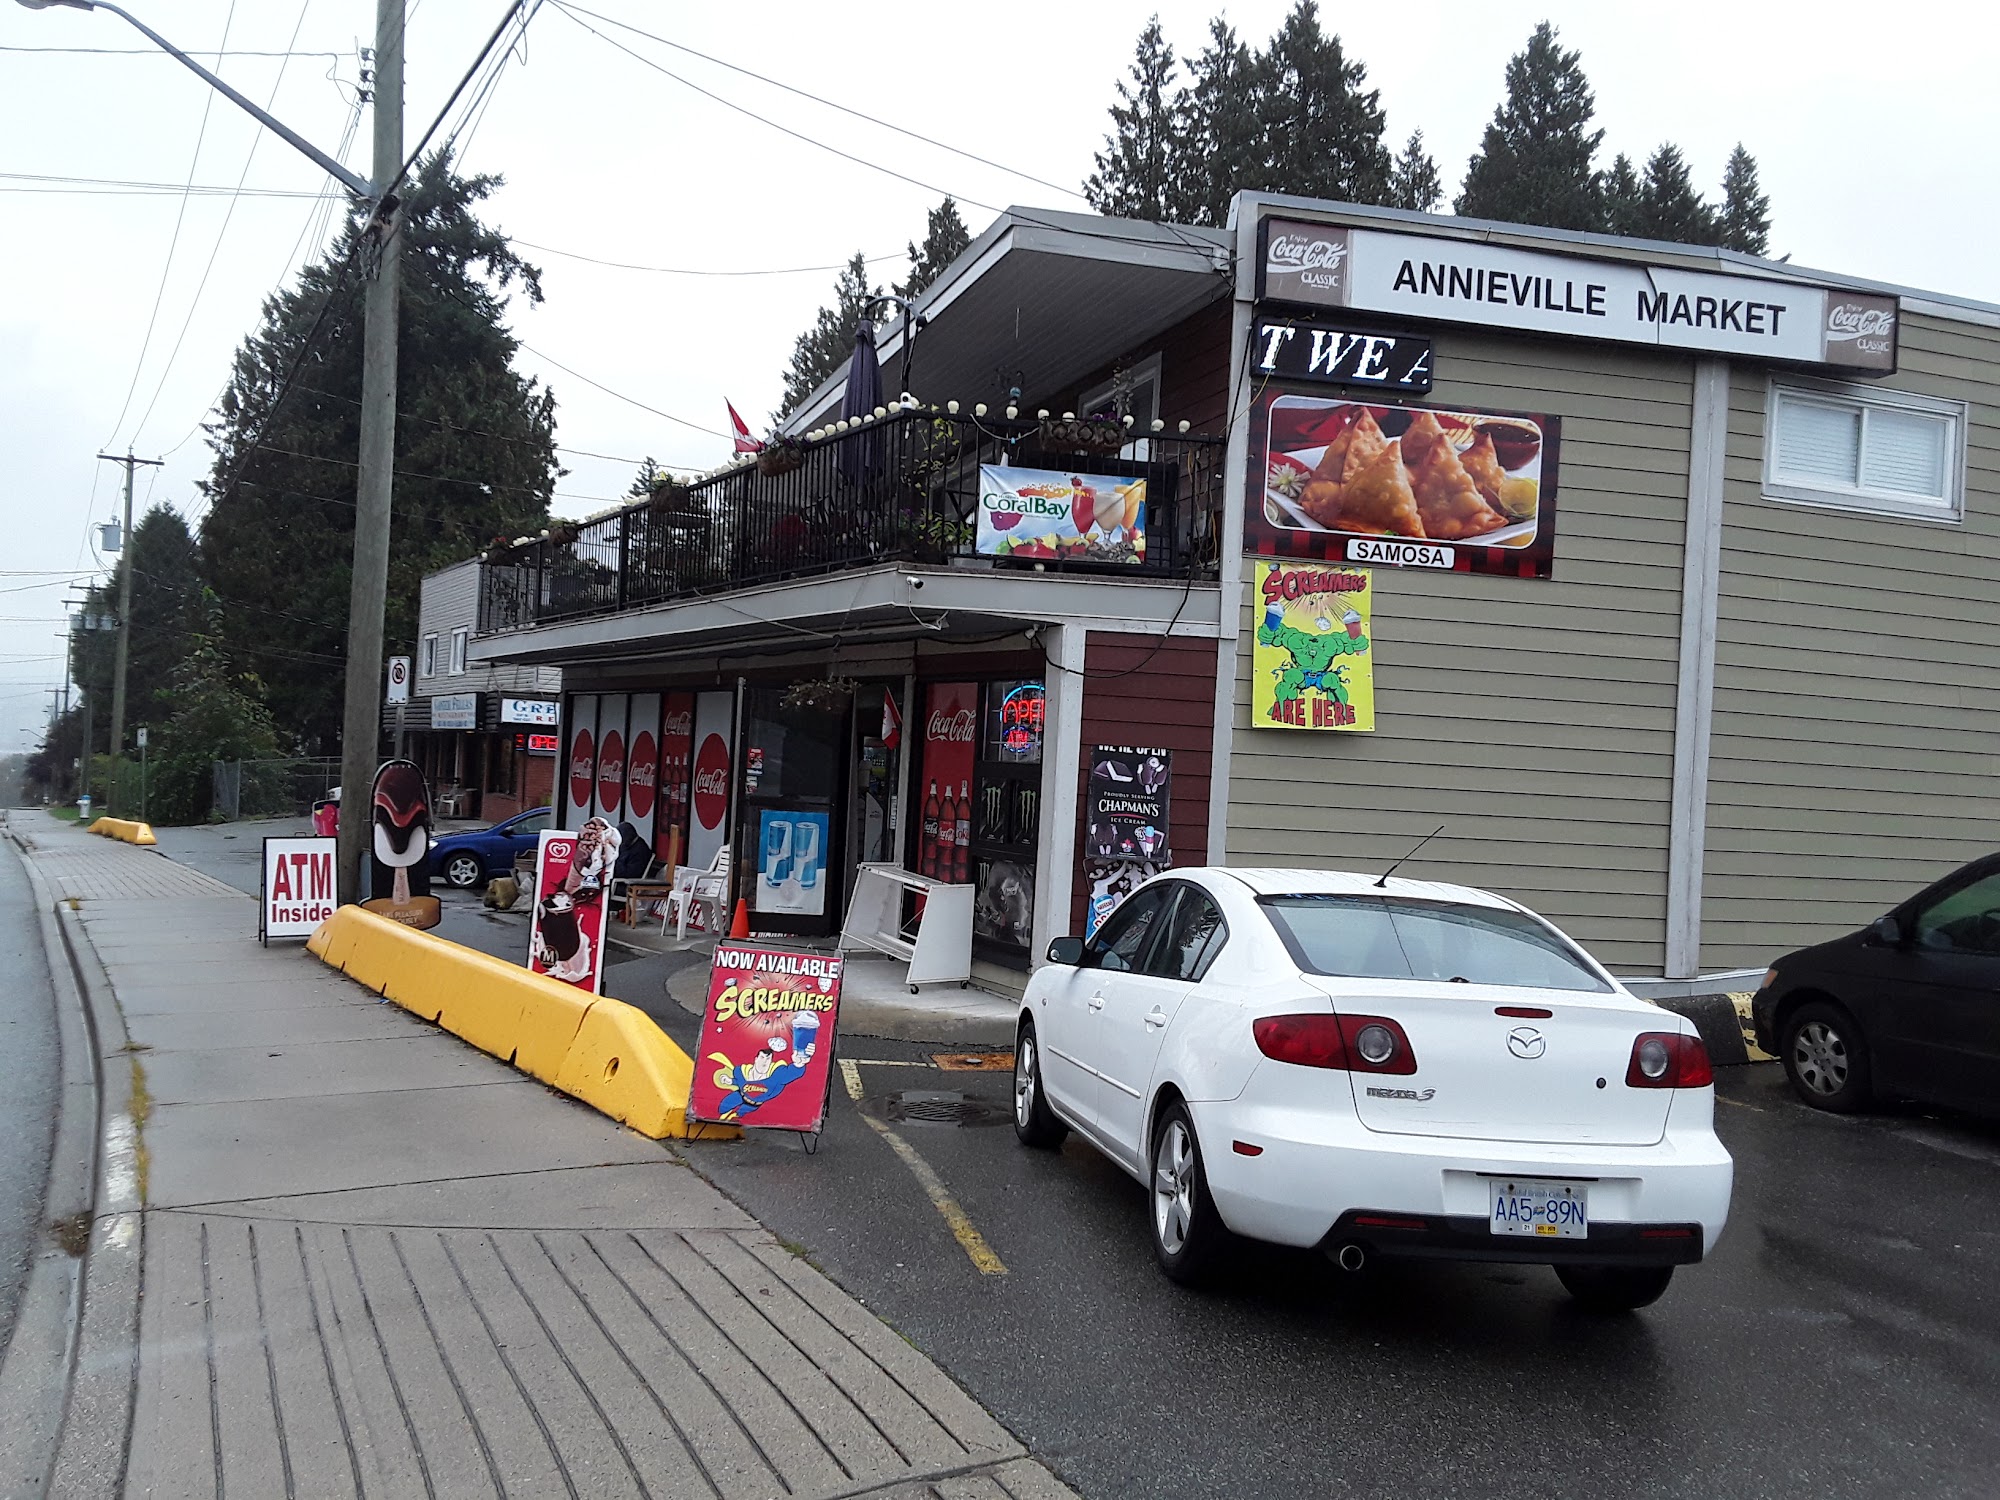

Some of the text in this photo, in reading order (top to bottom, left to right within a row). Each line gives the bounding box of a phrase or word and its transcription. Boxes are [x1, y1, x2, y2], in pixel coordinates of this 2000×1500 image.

[1301, 272, 1340, 287] CLASSIC
[1393, 260, 1787, 337] ANNIEVILLE MARKET
[1260, 325, 1296, 370] T
[1308, 329, 1396, 381] WE
[1857, 339, 1890, 352] CLASSIC
[983, 493, 1071, 520] CoralBay
[1356, 542, 1445, 565] SAMOSA
[1261, 569, 1368, 606] SCREAMERS
[926, 709, 976, 742] Coca-Cola
[1271, 698, 1356, 728] ARE HERE
[1098, 799, 1159, 817] CHAPMAN'S
[272, 853, 331, 901] ATM
[271, 903, 332, 923] Inside
[716, 950, 839, 979] NOW AVAILABLE
[714, 986, 834, 1022] SCREAMERS
